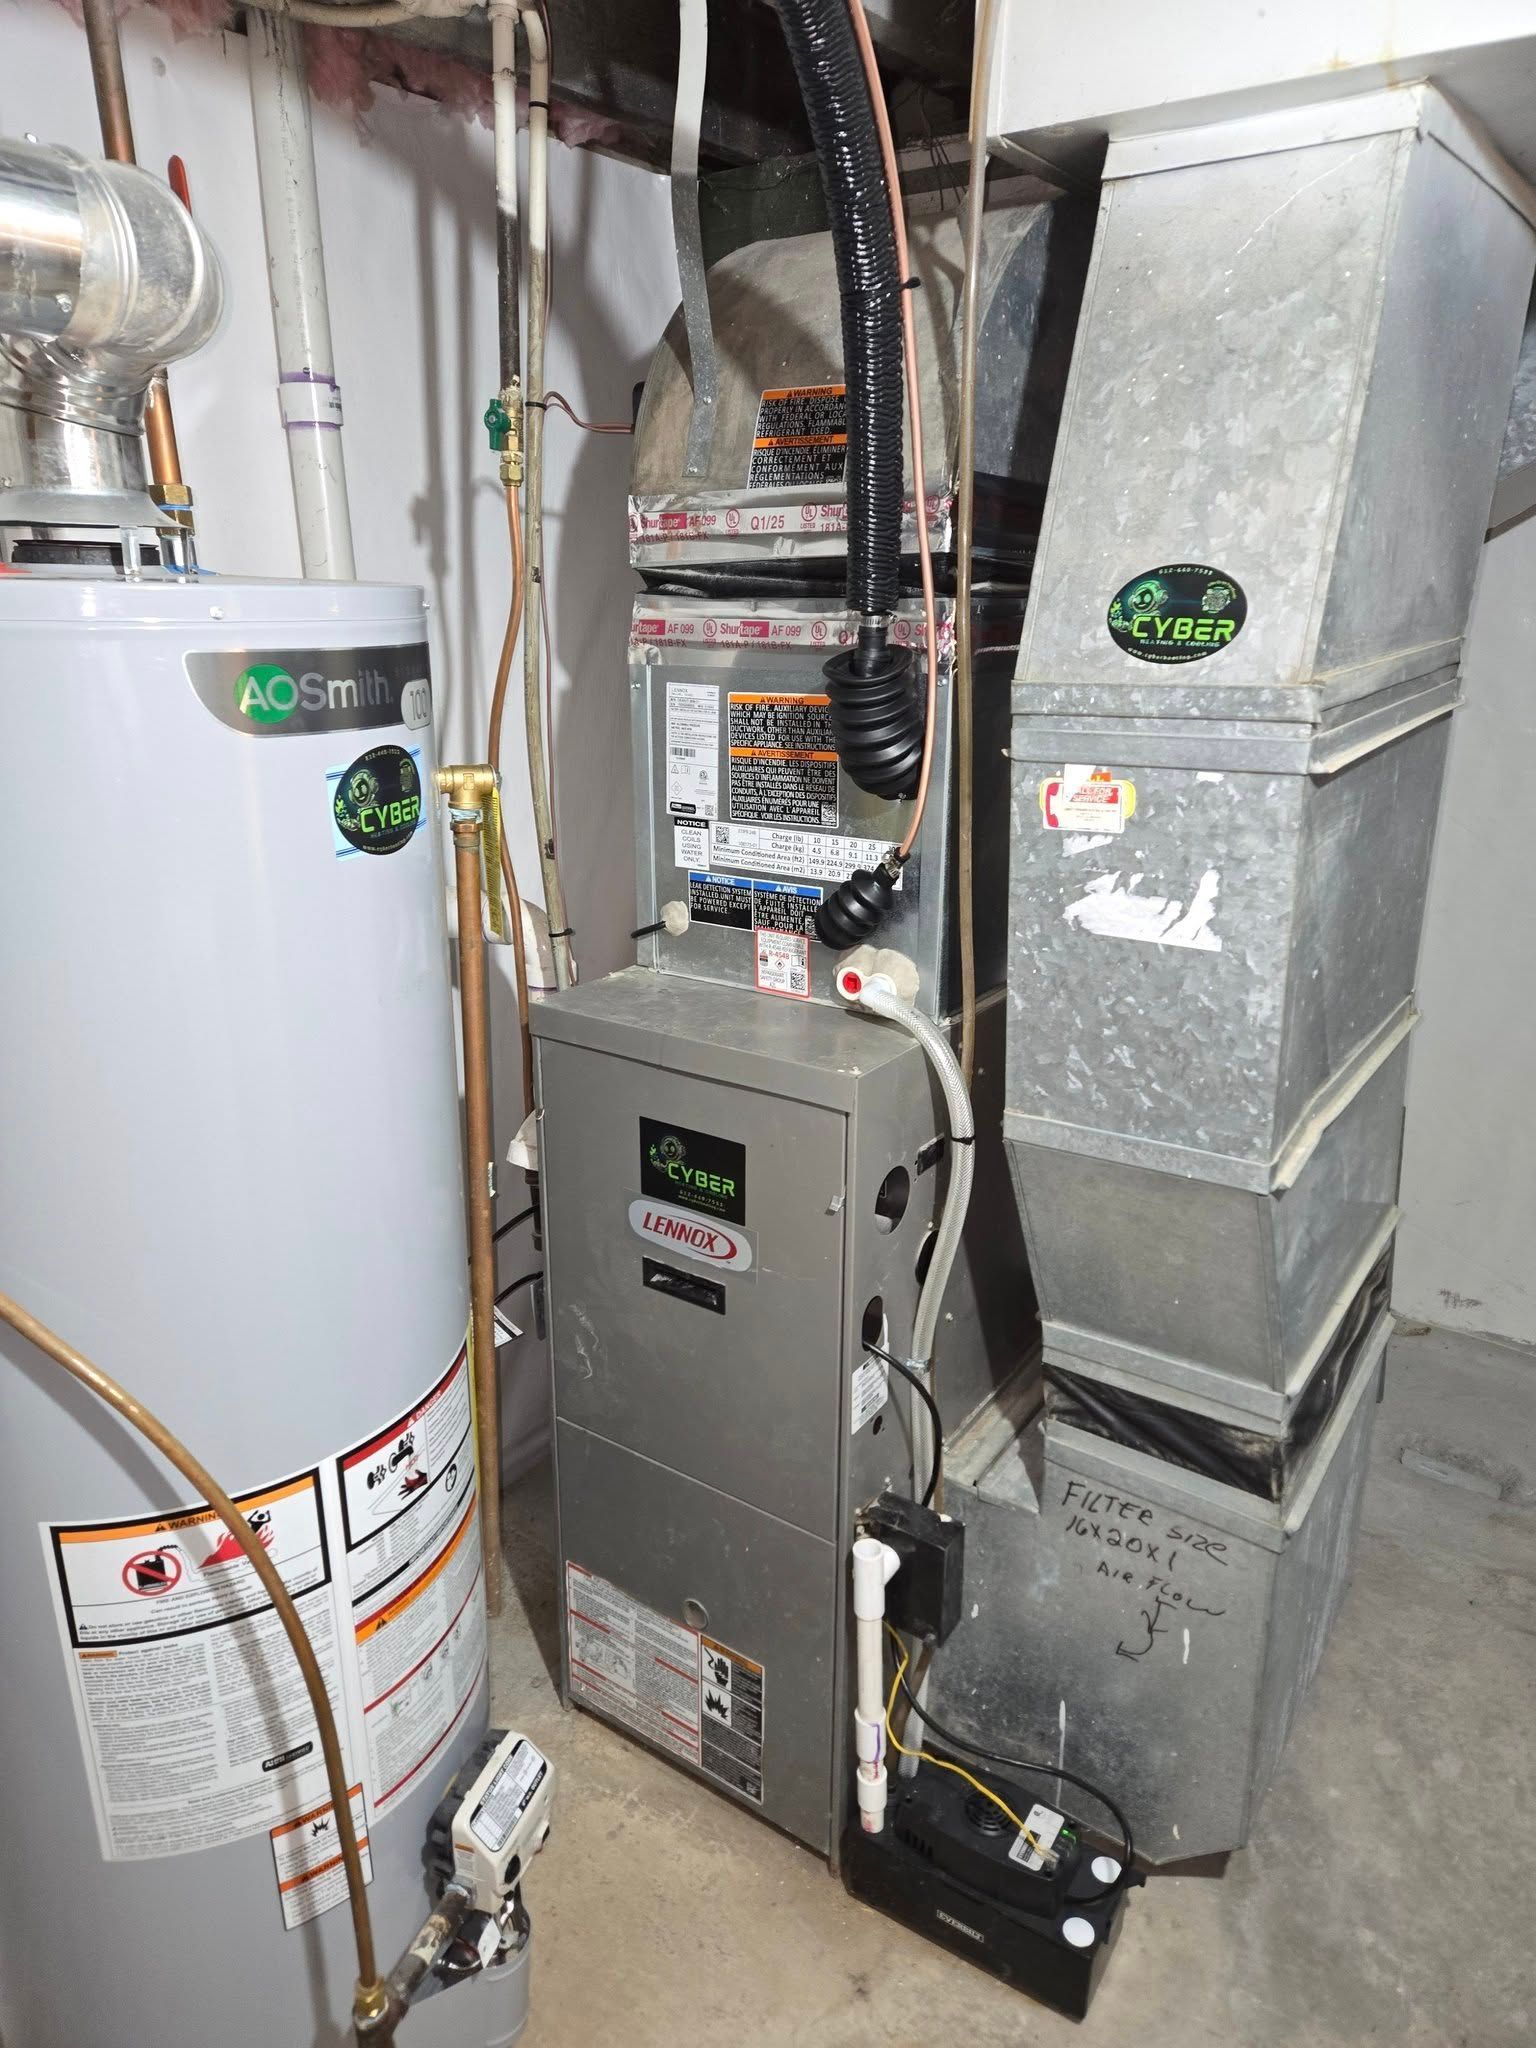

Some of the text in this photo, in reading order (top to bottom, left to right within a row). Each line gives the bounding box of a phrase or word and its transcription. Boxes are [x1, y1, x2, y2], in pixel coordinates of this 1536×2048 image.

[794, 387, 833, 398] WARNING
[760, 407, 793, 415] PROPERLY
[781, 413, 812, 421] FEDERAL
[756, 428, 805, 437] REFRIGERANT
[775, 436, 834, 445] AVERTISSEMENT
[754, 449, 775, 457] RISQUE
[752, 455, 818, 465] CORRECTEMENT
[825, 463, 842, 471] AUX
[751, 515, 784, 530] Q1/25
[668, 624, 679, 633] AF
[681, 624, 694, 634] 099
[771, 625, 784, 636] AF
[786, 626, 801, 637] 099
[1132, 616, 1236, 642] CYBER
[774, 705, 807, 713] AUXILIARY
[777, 712, 804, 720] IGNITION
[777, 720, 812, 728] INSTALLED
[789, 727, 805, 735] THAN
[758, 750, 814, 759] AVERTISSEMENT
[732, 757, 752, 765] RISQUE
[801, 761, 836, 769] DISPOSITIFS
[732, 765, 764, 773] AUXILIAIRES
[778, 768, 804, 776] PEUVENT
[812, 777, 835, 785] DOIVENT
[807, 792, 836, 801] DISPOSITIFS
[732, 803, 767, 811] UTILISATION
[770, 805, 784, 813] AVEC
[361, 795, 420, 833] CYBER
[772, 833, 792, 841] Charge
[794, 835, 804, 843] (lb)
[771, 843, 792, 851] Charge
[793, 844, 805, 853] (kg)
[713, 846, 740, 854] Minimum
[741, 849, 776, 859] Conditioned
[777, 853, 790, 861] Area
[792, 855, 805, 864] (ft2)
[809, 857, 825, 865] 149.9
[713, 855, 739, 864] Minimum
[741, 859, 776, 869] Conditioned
[777, 863, 790, 871] Area
[792, 865, 805, 874] (m2)
[712, 876, 735, 885] NOTICE
[703, 884, 752, 896] DETECTION SYSTEM
[783, 886, 798, 894] AVIS
[699, 897, 751, 910] POWERED EXCEPT
[736, 895, 751, 904] MUST
[766, 900, 785, 908] FUITE
[704, 905, 728, 914] SERVICE
[775, 920, 793, 930] POUR
[769, 950, 790, 960] R-454B
[668, 1162, 735, 1197] CYBER
[643, 1212, 718, 1253] LENNOX
[1062, 1481, 1153, 1526] FILTER
[168, 1513, 217, 1529] WARNIN
[1097, 1561, 1226, 1616] AIR FLOW
